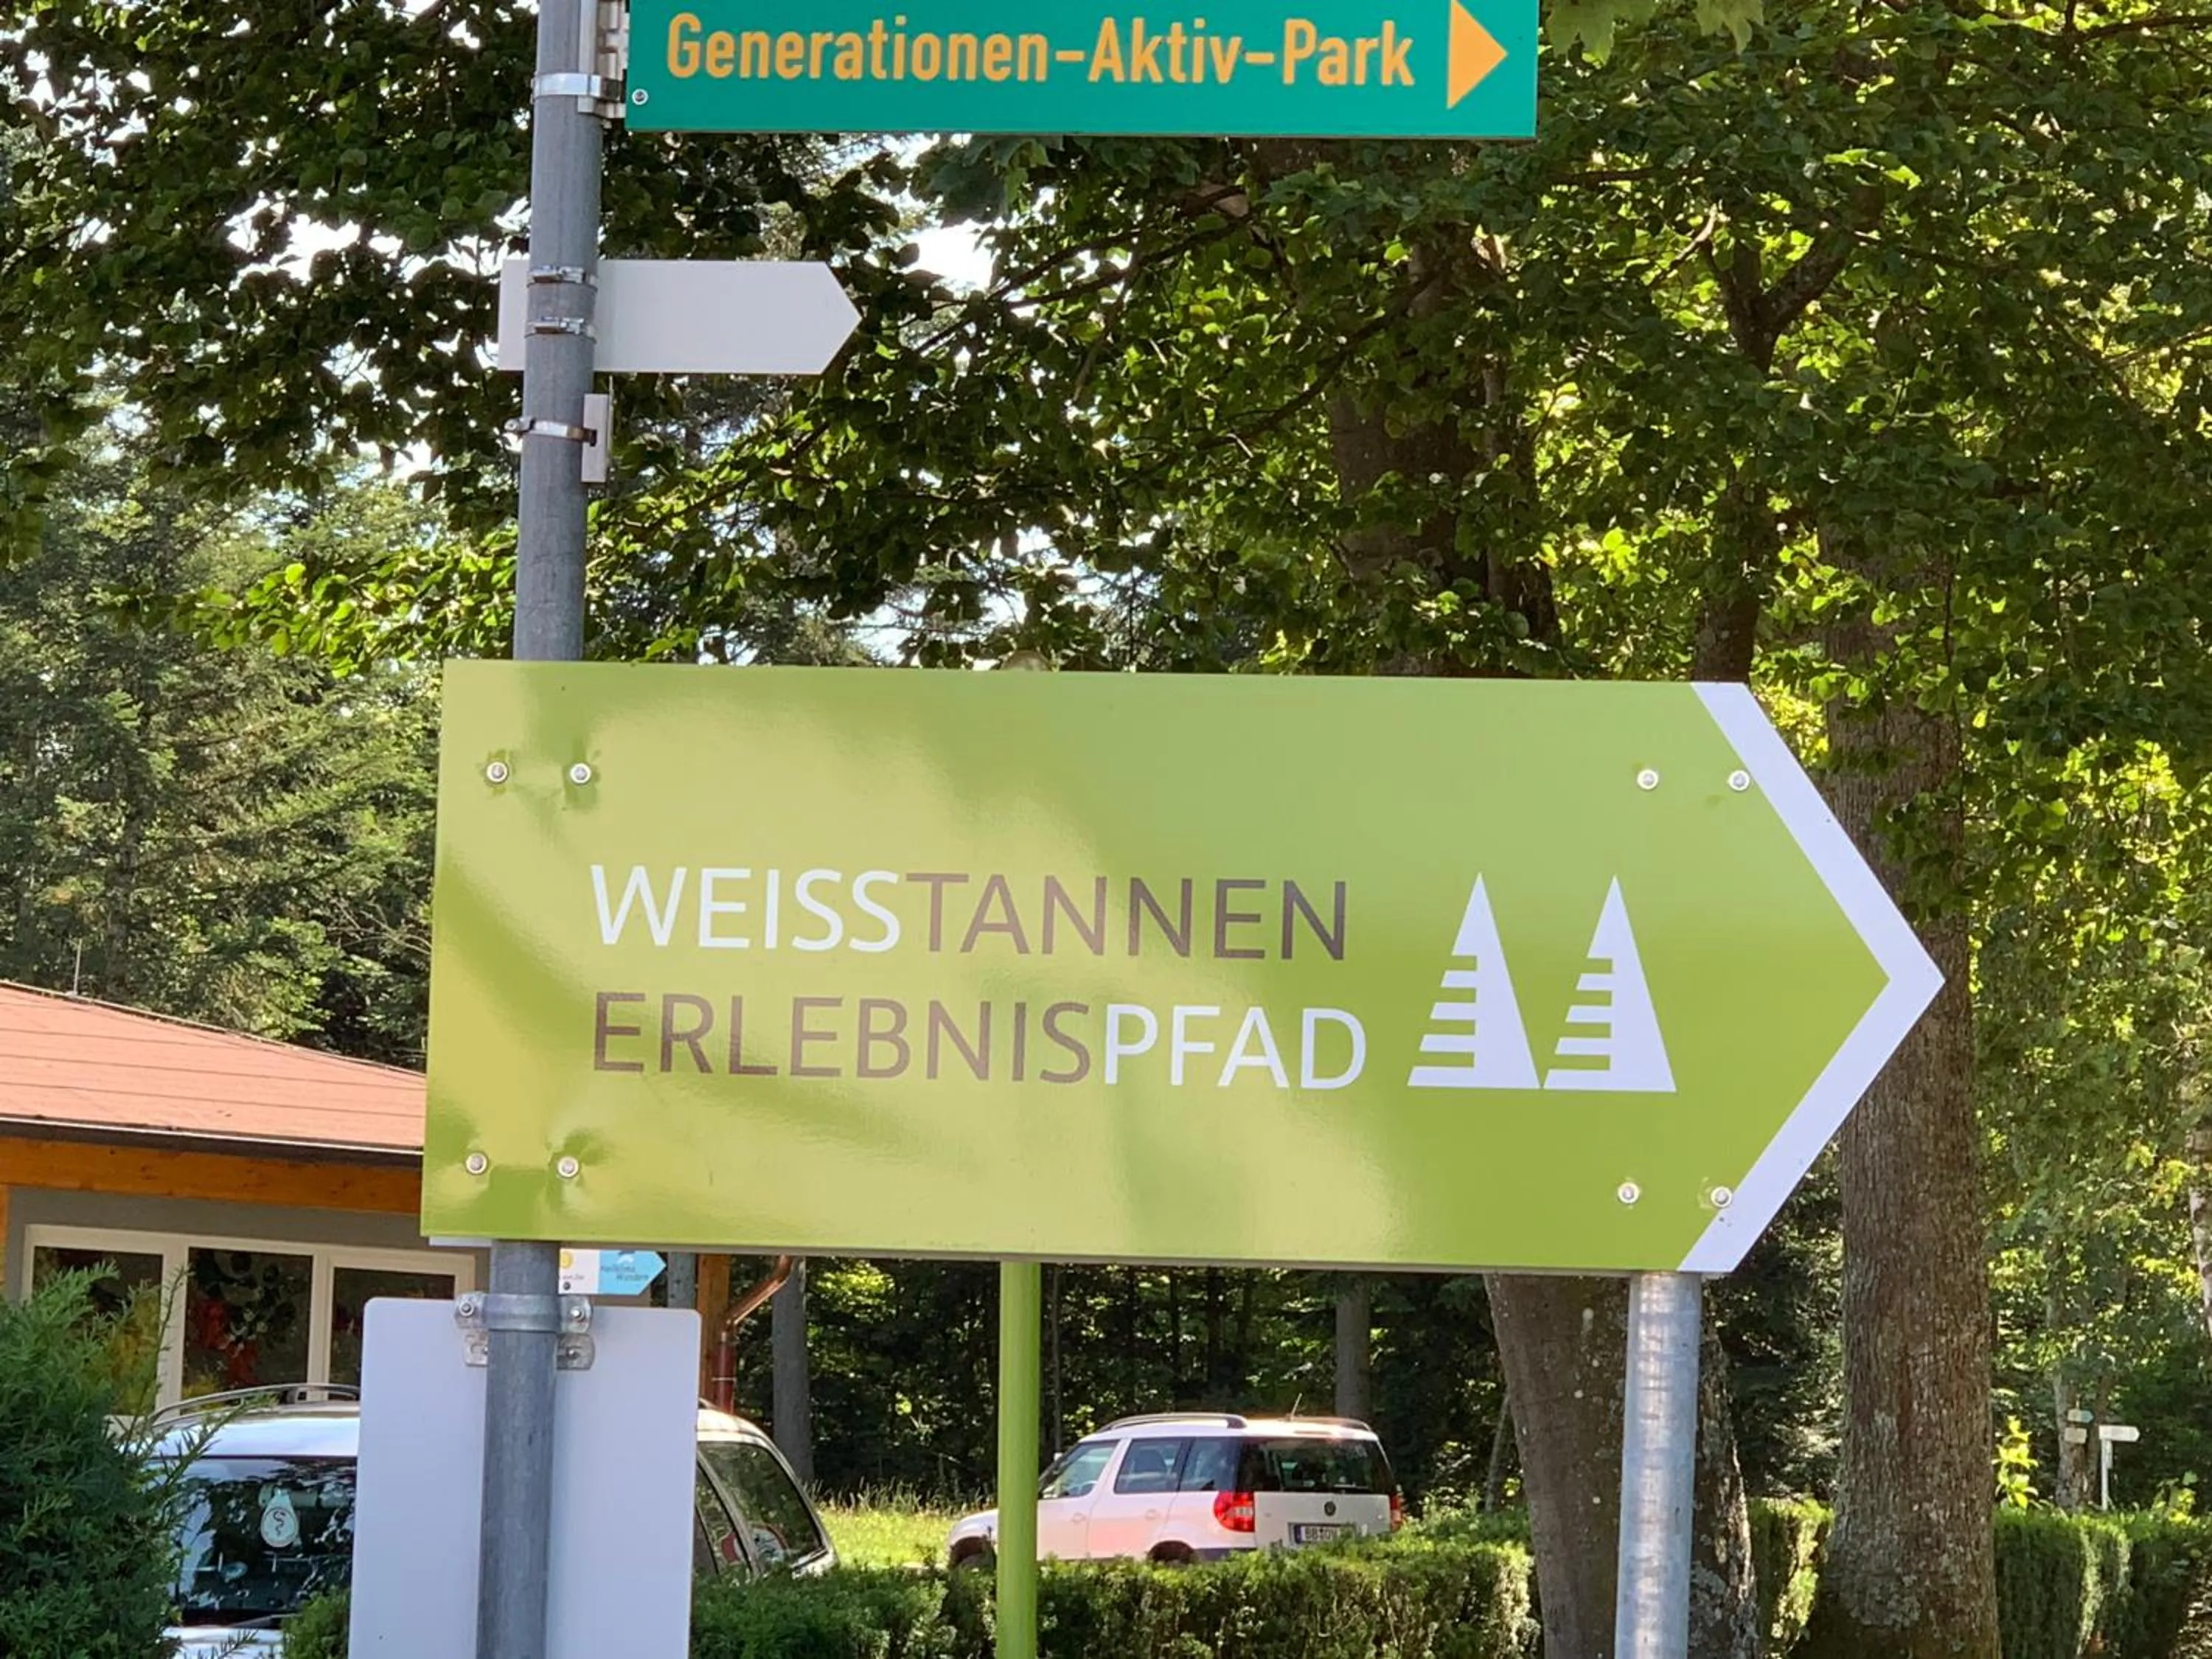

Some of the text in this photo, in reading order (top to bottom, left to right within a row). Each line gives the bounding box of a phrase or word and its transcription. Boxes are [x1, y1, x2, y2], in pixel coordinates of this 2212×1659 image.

[667, 12, 1415, 86] Generationen-Aktiv-Park
[591, 865, 1346, 961] WEISSTANNEN
[594, 992, 1366, 1090] ERLEBNISPFAD
